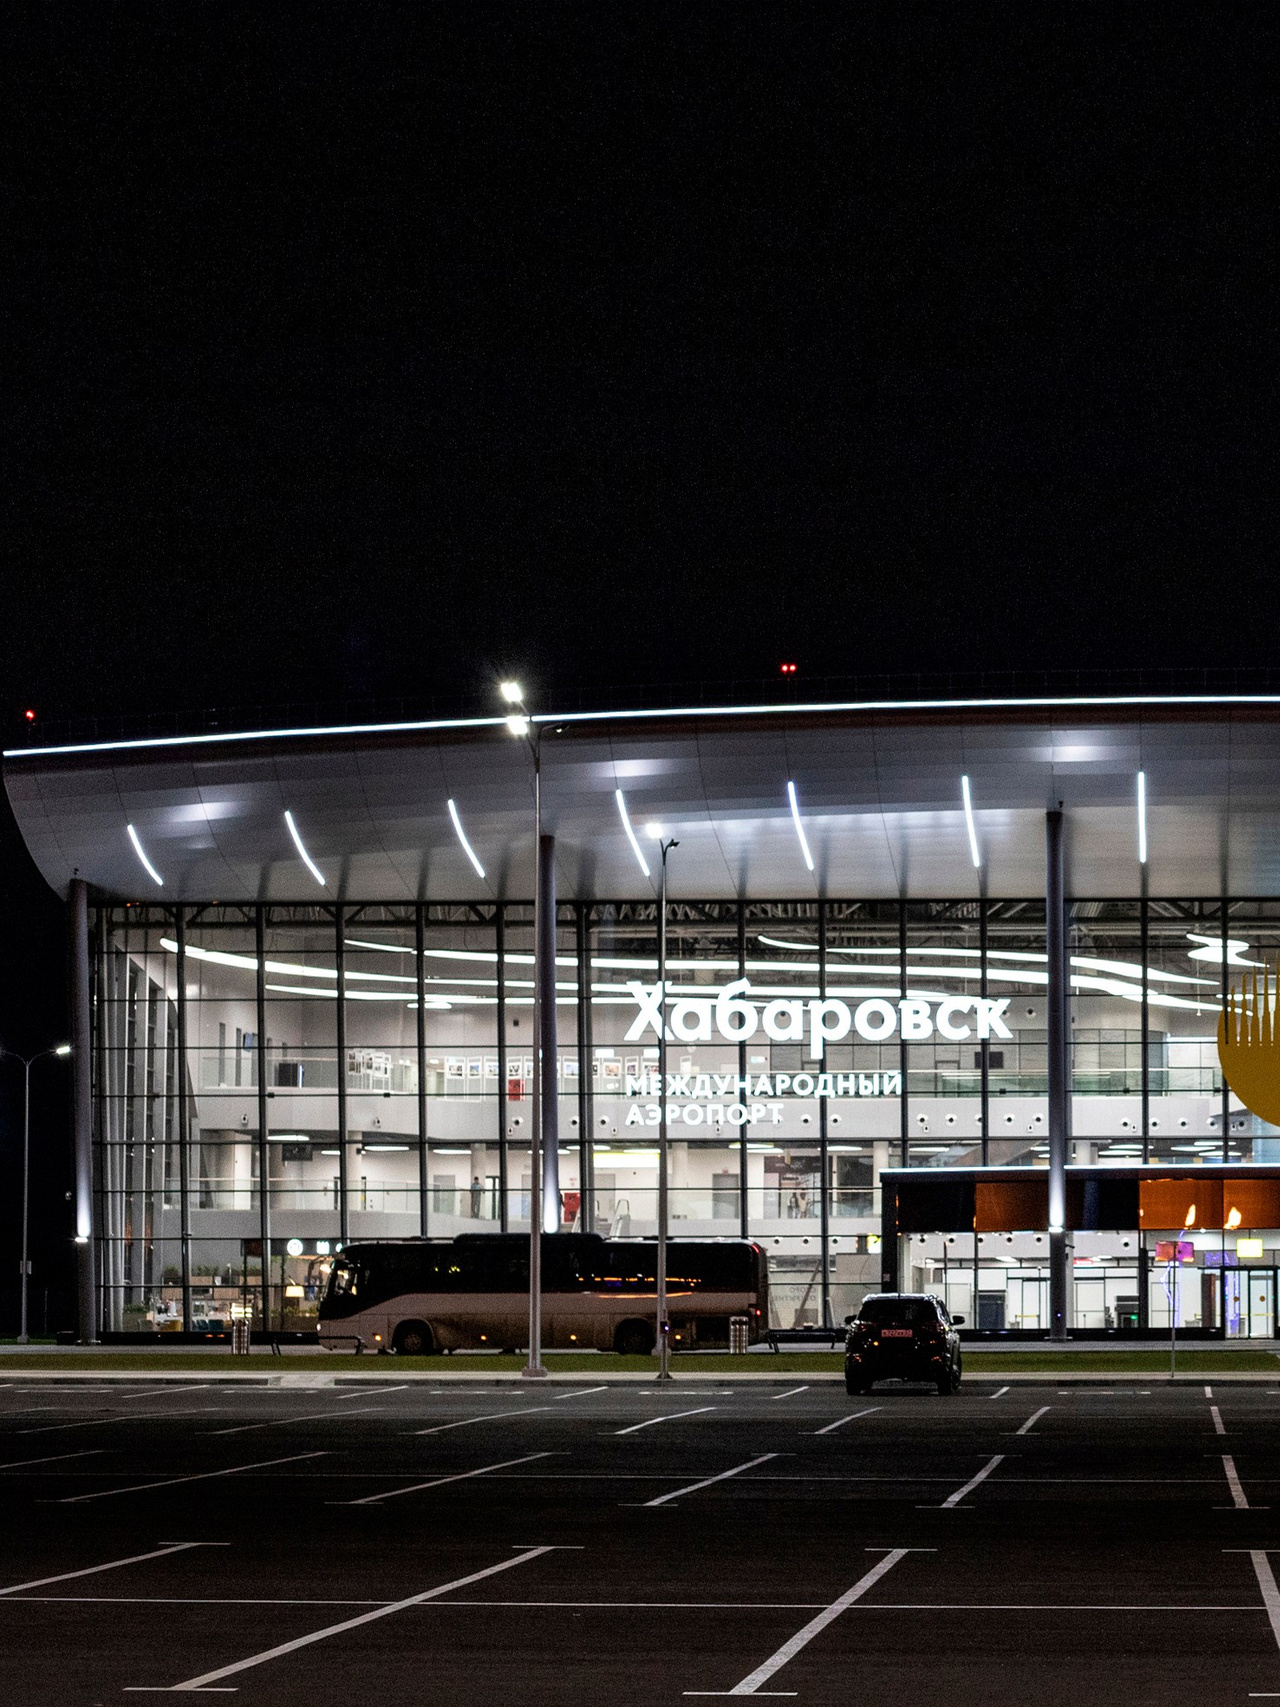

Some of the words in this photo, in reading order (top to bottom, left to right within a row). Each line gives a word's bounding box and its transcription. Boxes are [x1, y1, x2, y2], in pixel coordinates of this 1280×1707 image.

[623, 977, 1014, 1060] Хабаровск
[625, 1070, 903, 1099] МЕЖДУНАРОДНЫЙ
[625, 1103, 784, 1126] АЭРОПОРТ
